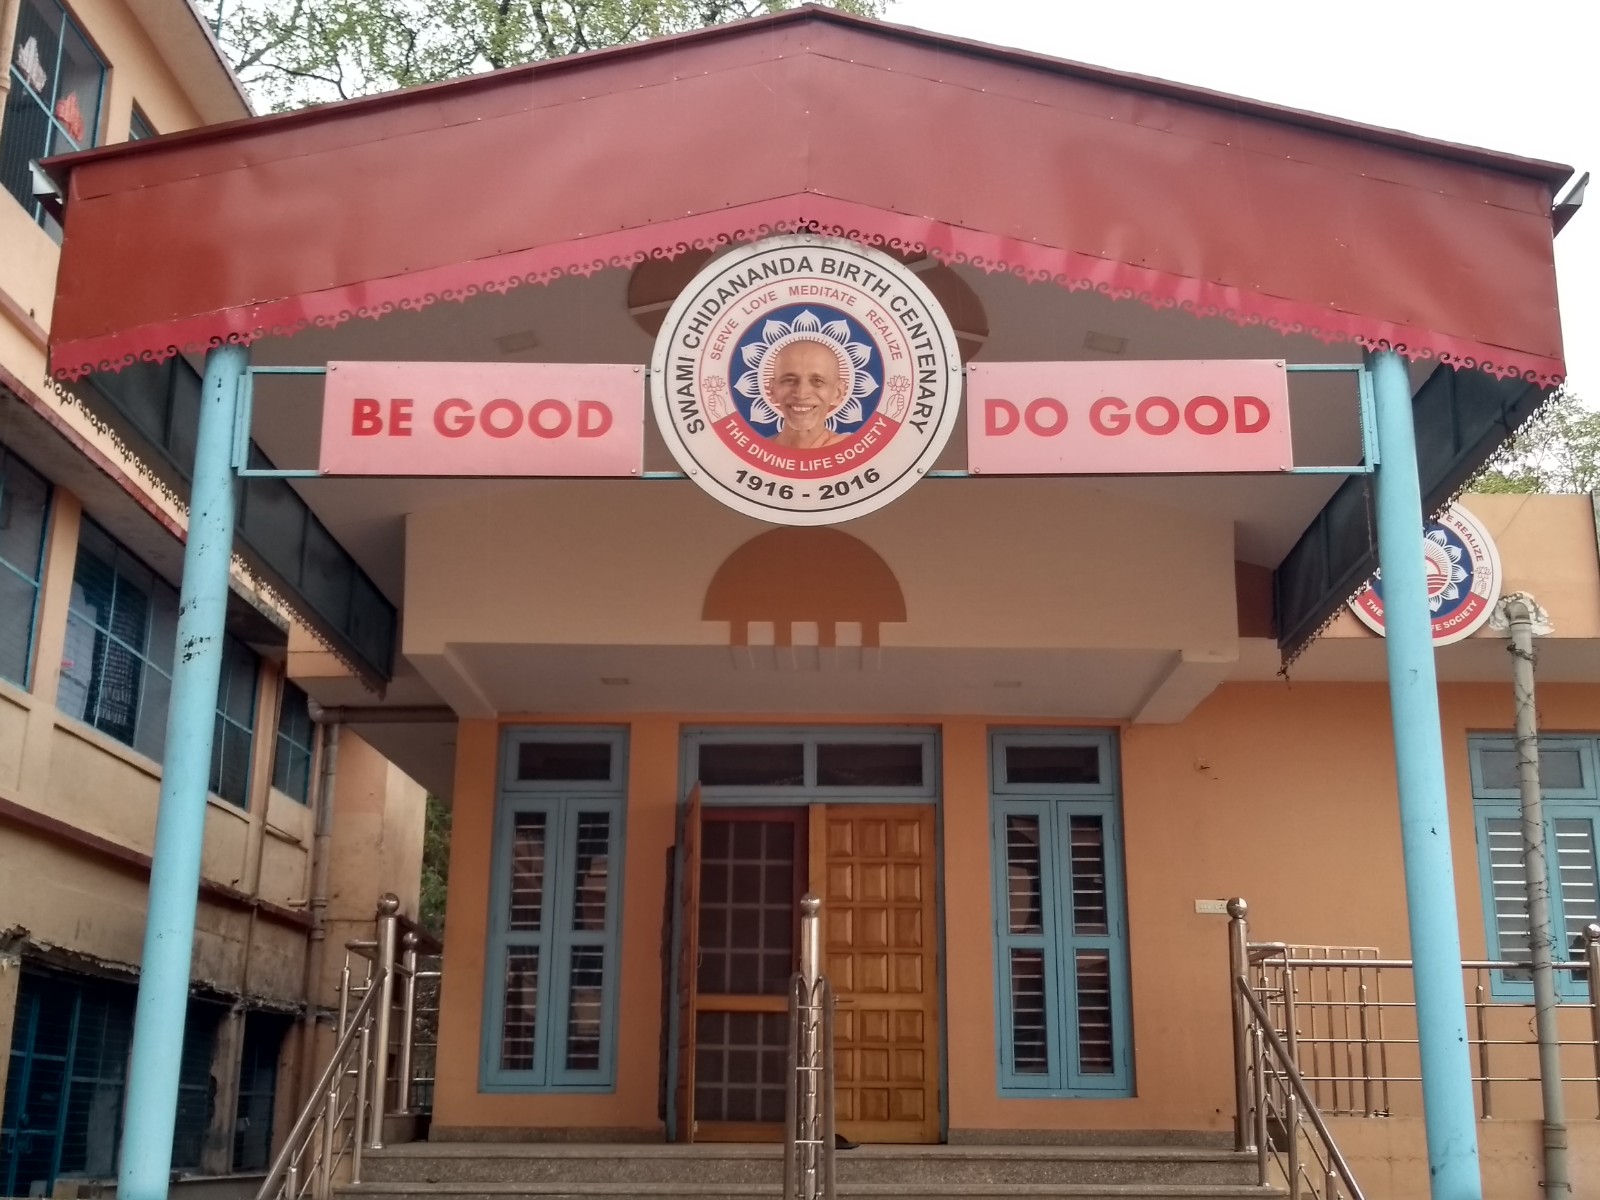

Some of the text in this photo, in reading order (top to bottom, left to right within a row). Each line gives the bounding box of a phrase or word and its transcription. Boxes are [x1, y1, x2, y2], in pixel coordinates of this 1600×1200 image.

[710, 285, 903, 361] SERVE LOVE MEDITATE REALIZE
[676, 256, 937, 435] SWAMI CHIDANANDA BIRTH CENTENARY
[351, 398, 613, 439] BE GOOD
[984, 395, 1271, 437] DO GOOD
[725, 416, 888, 472] THE DIVINE LIFE SOCIETY
[735, 469, 794, 500] 1916
[819, 467, 881, 500] 2016
[1454, 520, 1484, 562] REALIZE
[1366, 598, 1384, 617] THE
[1443, 600, 1477, 629] SOCIETY
